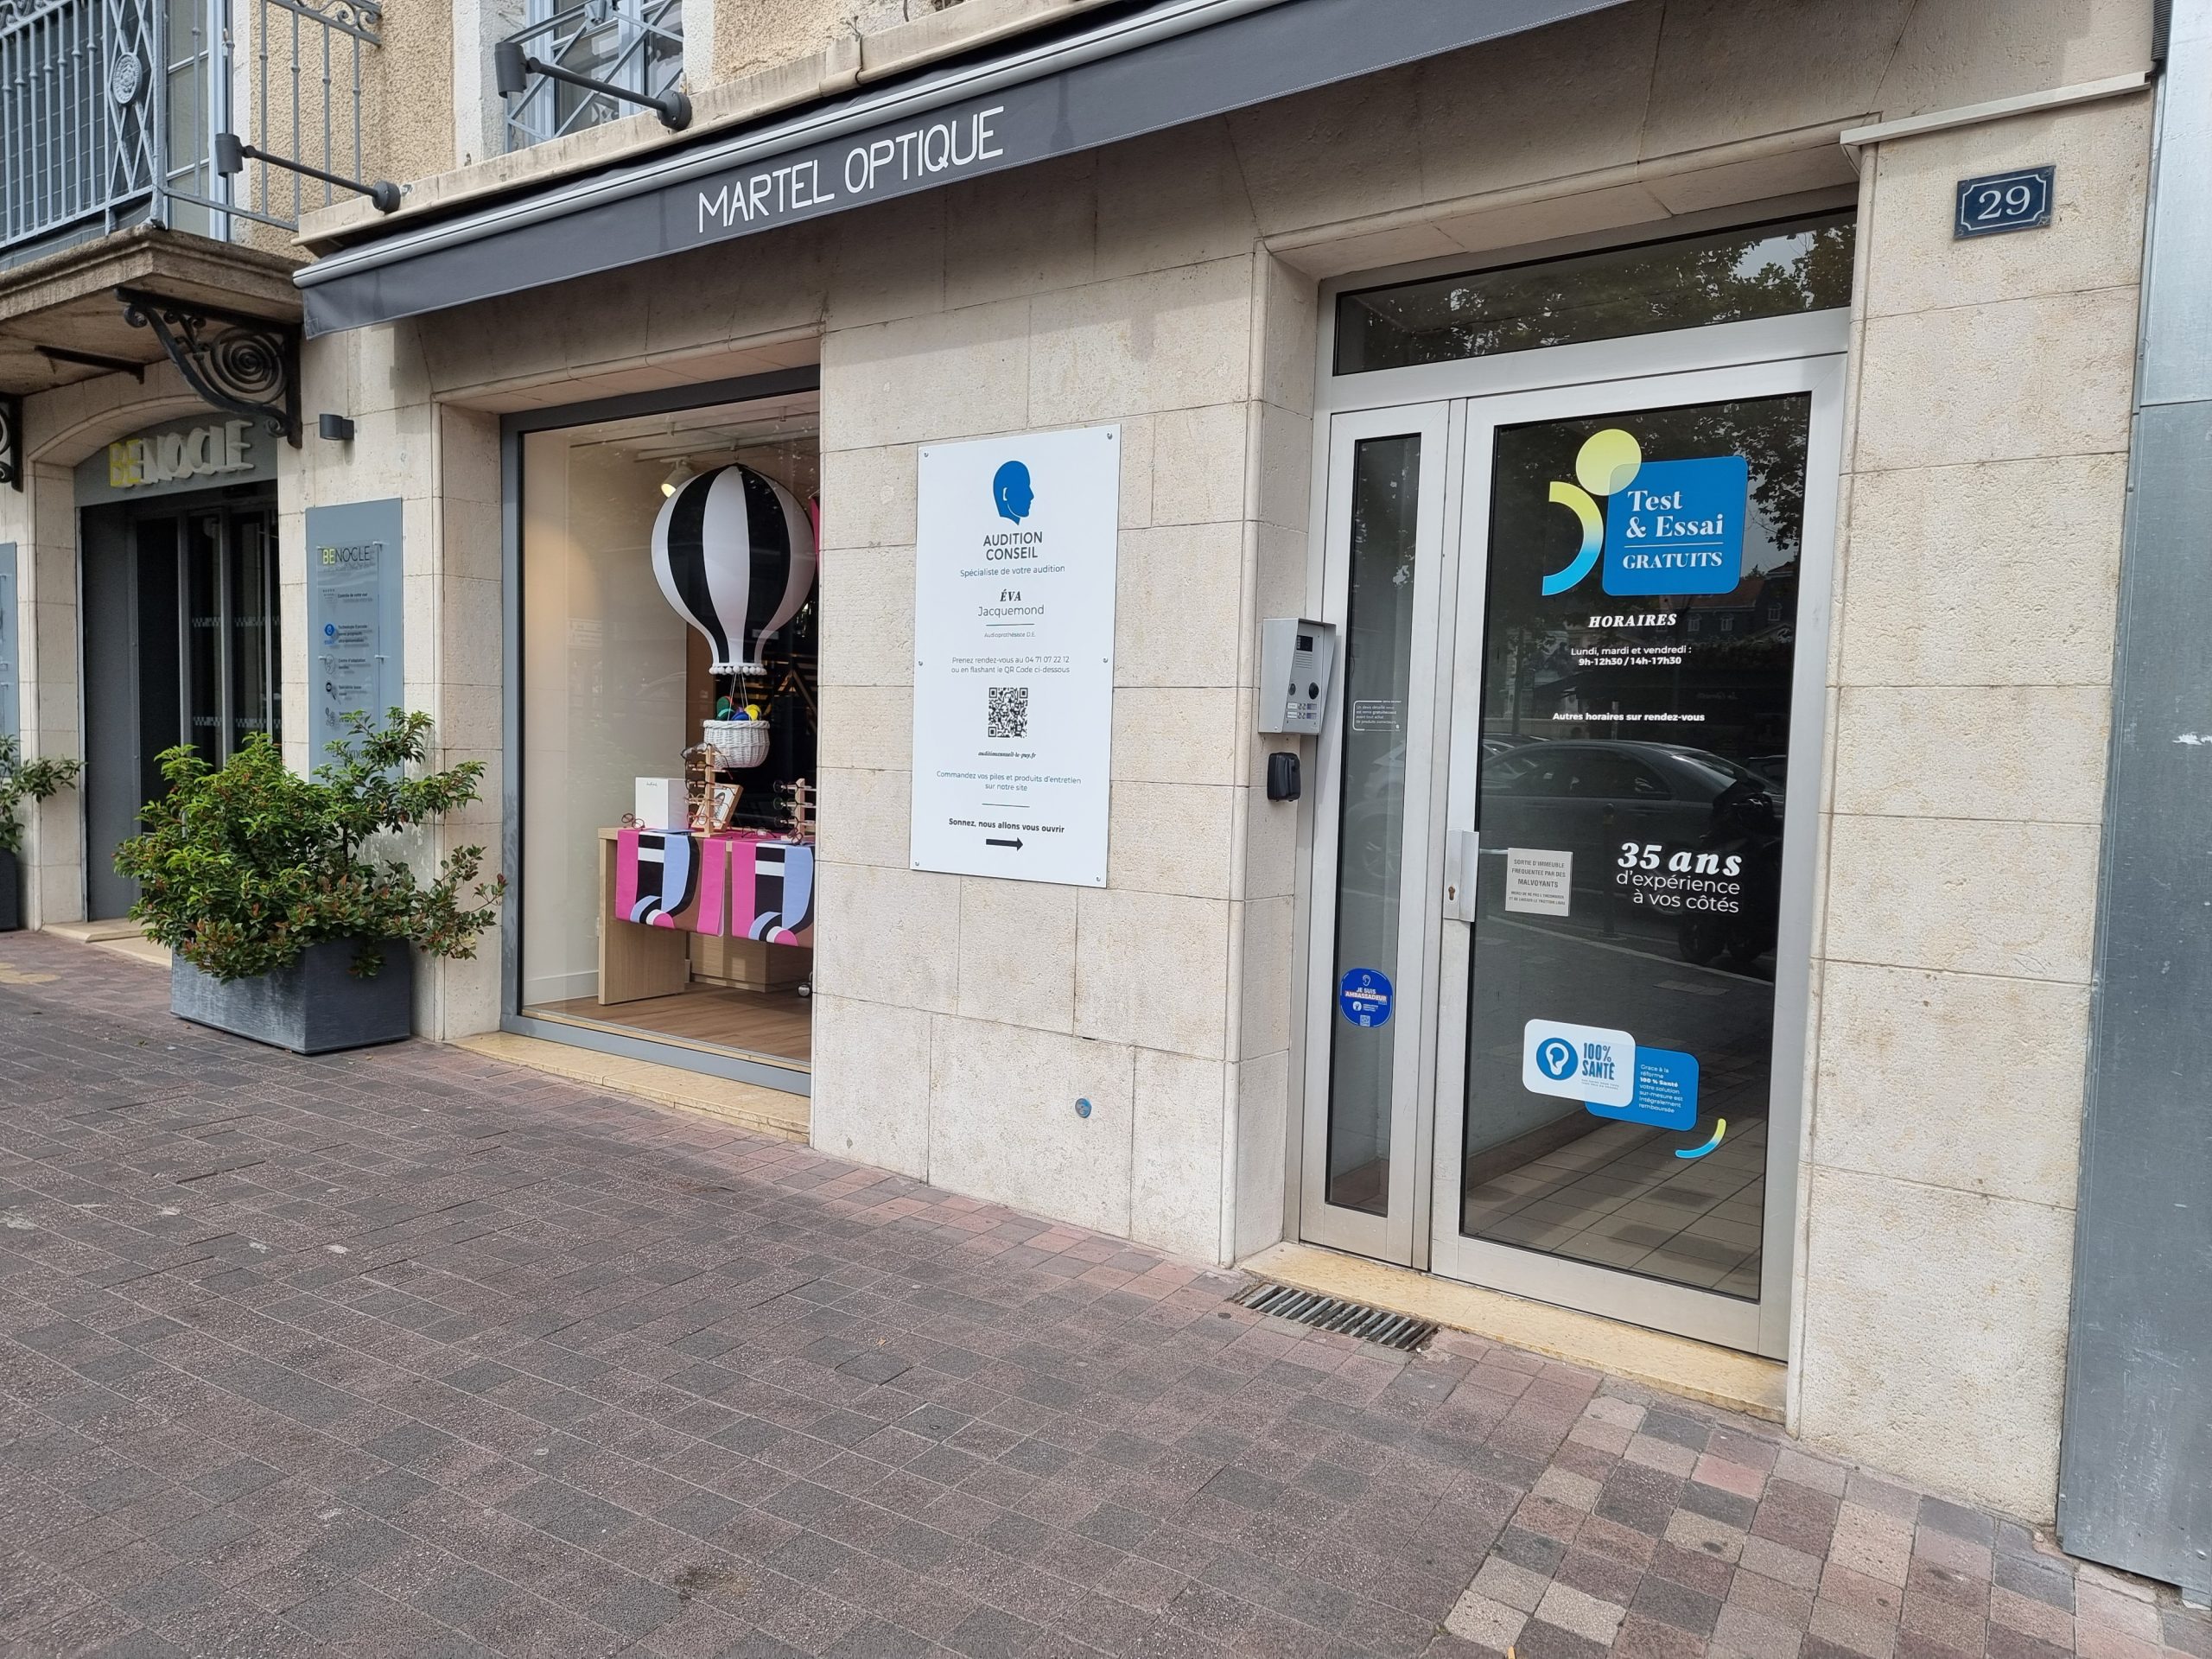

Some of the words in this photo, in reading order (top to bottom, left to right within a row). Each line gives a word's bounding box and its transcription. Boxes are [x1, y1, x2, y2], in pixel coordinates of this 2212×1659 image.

[699, 160, 835, 233] MARTEL
[844, 105, 1004, 194] OPTIQUE
[1977, 186, 2031, 220] 29
[1627, 490, 1683, 512] Test
[1625, 517, 1647, 538] &
[1656, 513, 1724, 537] Essai
[982, 531, 1043, 547] AUDITION
[322, 545, 371, 564] BENOCLE
[986, 546, 1038, 561] CONSEIL
[1622, 551, 1723, 569] GRATUITS
[960, 568, 999, 578] Spécialiste
[1001, 567, 1010, 575] de
[1033, 564, 1065, 574] audition
[1000, 588, 1021, 602] ÉVA
[977, 604, 1045, 618] Jacquemond
[1588, 613, 1677, 628] HORAIRES
[1571, 647, 1599, 657] Lundi,
[1601, 645, 1630, 655] mardi
[1643, 645, 1687, 655] vendredi
[1578, 658, 1623, 666] 9h-12h30
[1630, 657, 1682, 665] 14h-17h30
[1643, 713, 1706, 721] rendez-vous
[936, 771, 976, 779] Commandez
[989, 772, 1005, 781] piles
[1014, 774, 1042, 783] produits
[1043, 775, 1082, 785] d'entretien
[949, 817, 977, 827] Sonnez,
[997, 821, 1020, 830] allons
[1041, 825, 1065, 834] ouvrir
[1617, 842, 1662, 870] 35
[1668, 851, 1743, 877] ans
[1517, 878, 1559, 888] MALVOYANTS
[1616, 870, 1740, 895] d'expérience
[1633, 888, 1643, 904] à
[1649, 893, 1681, 907] vos
[1686, 893, 1739, 913] côtés
[1583, 1042, 1611, 1062] 100%
[1581, 1059, 1615, 1080] SANTÉ
[1656, 1085, 1680, 1095] solution
[1659, 1079, 1679, 1088] Santé
